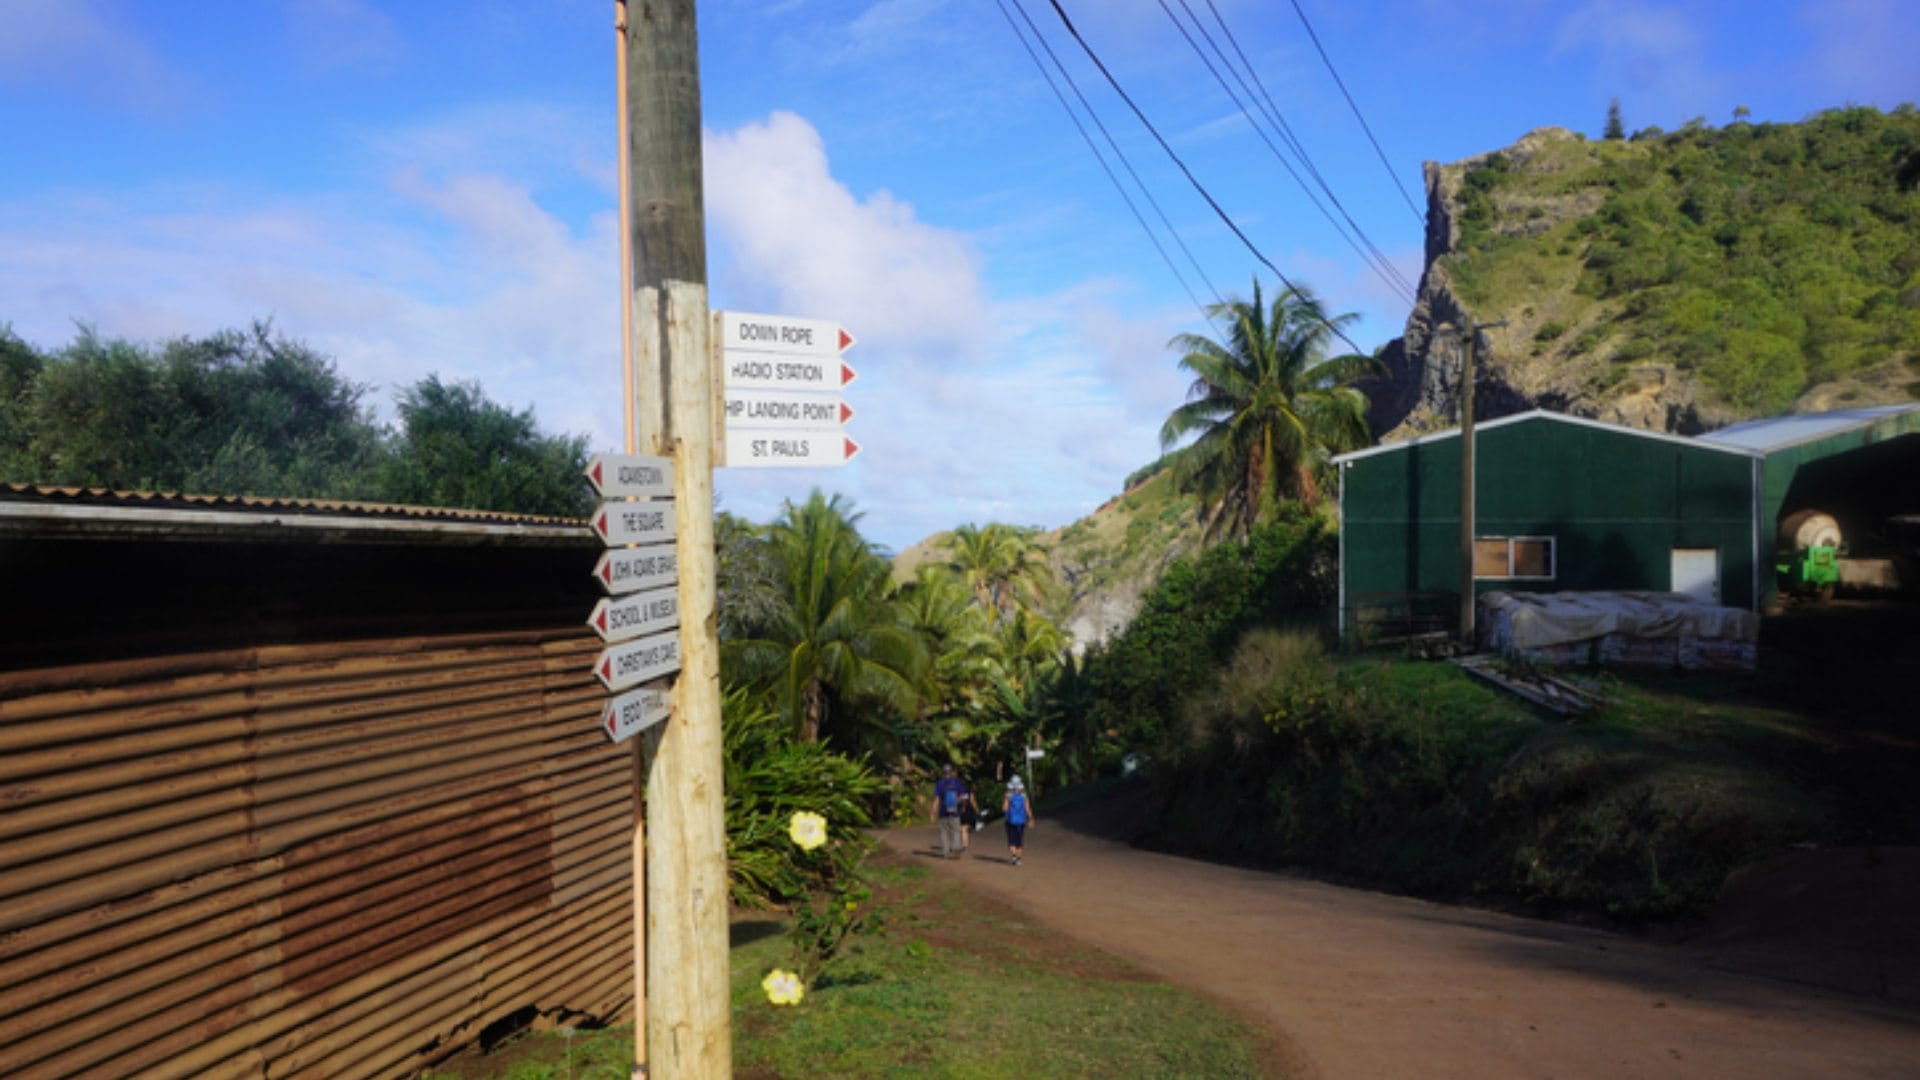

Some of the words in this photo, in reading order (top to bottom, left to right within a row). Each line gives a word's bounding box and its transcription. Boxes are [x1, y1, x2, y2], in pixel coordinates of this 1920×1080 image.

[739, 322, 777, 342] DOWN
[782, 326, 813, 345] ROPE
[776, 363, 823, 381] STATION
[724, 400, 744, 417] HIP
[747, 401, 800, 420] LANDING
[803, 403, 835, 420] POINT
[771, 440, 810, 457] PAULS
[622, 511, 638, 533] THE
[638, 511, 664, 532] SQUARE
[613, 560, 633, 580] JOHN
[633, 557, 656, 577] ADAMS
[610, 604, 642, 630] SCHOOL
[623, 700, 640, 726] ECO
